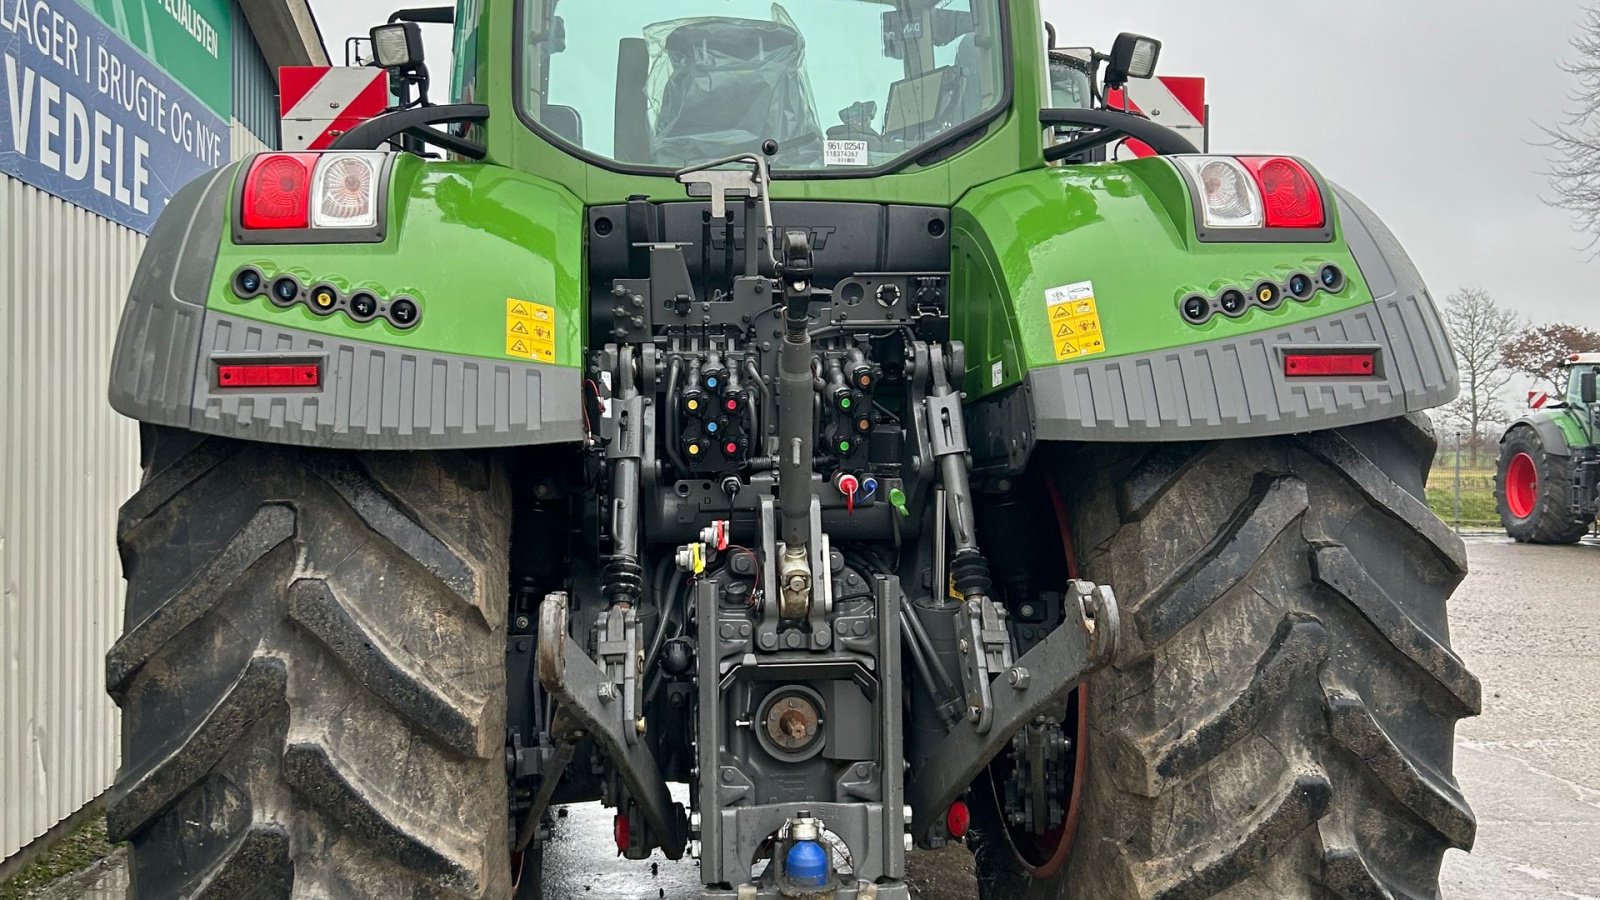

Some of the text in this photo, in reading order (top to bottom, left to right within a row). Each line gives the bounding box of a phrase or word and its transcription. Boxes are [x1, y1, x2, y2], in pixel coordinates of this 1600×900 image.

[158, 0, 218, 59] ECIALISTEN
[4, 53, 149, 214] VEDELE
[98, 45, 166, 135] BRUGTE
[171, 103, 192, 152] OG
[196, 120, 221, 169] NYE
